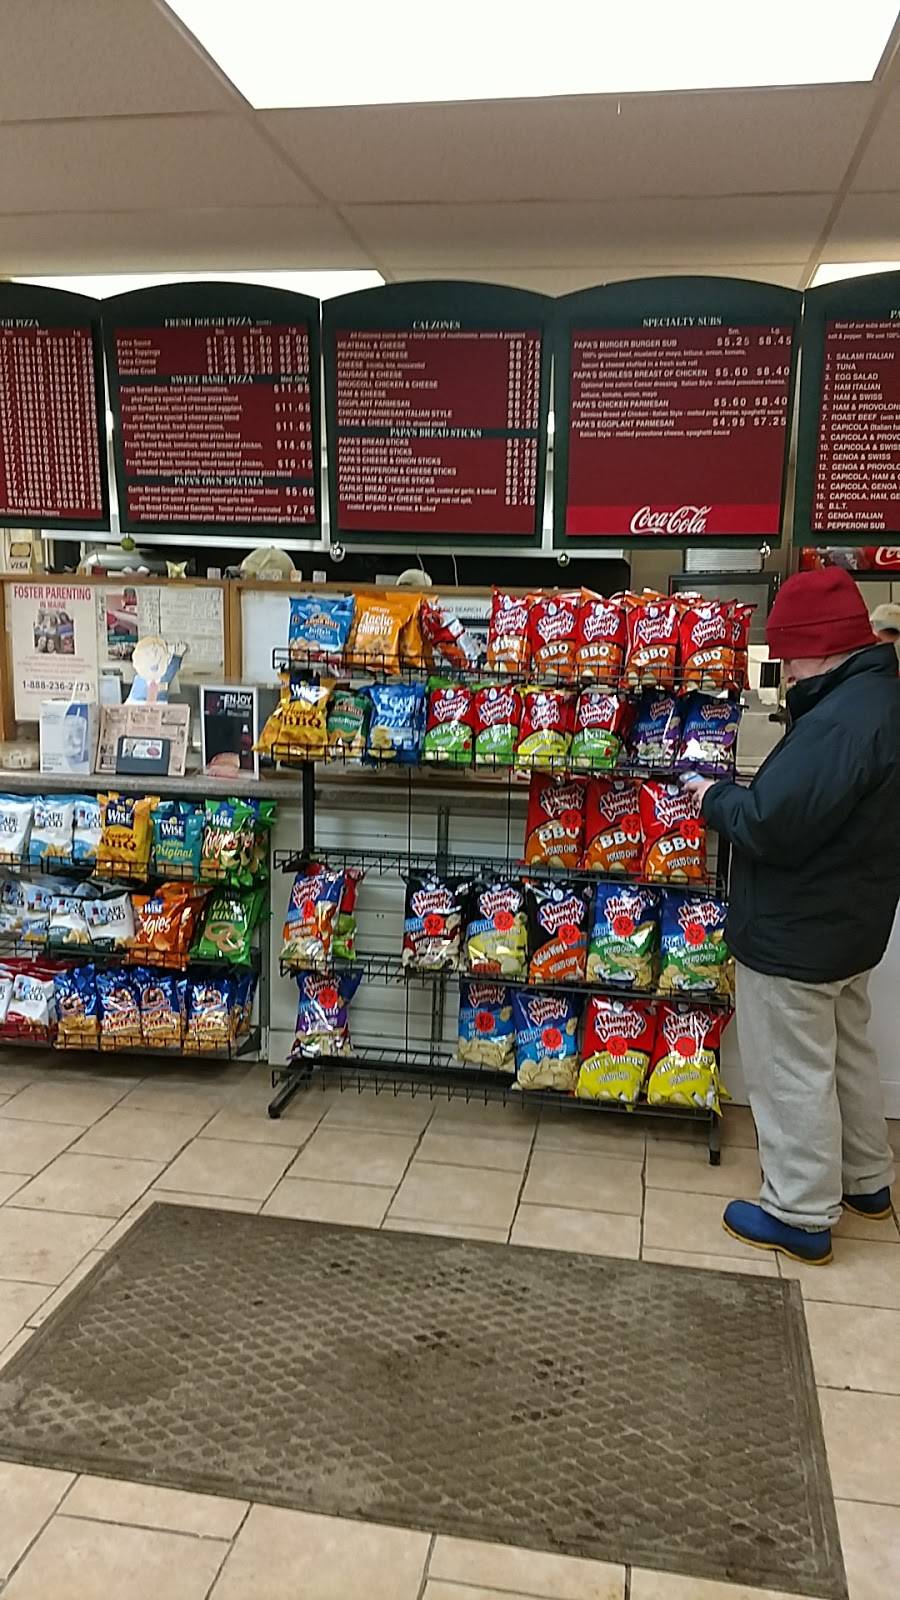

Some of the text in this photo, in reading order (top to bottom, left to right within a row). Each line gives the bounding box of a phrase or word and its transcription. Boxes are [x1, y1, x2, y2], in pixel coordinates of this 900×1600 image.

[16, 318, 40, 328] PIZZA
[227, 316, 252, 327] PIZZA
[412, 319, 461, 330] CALZONES
[642, 316, 722, 327] SPECIALTY SUBS
[574, 340, 598, 349] PAPA'S
[599, 340, 629, 348] BURGER
[630, 340, 661, 348] BURGER
[662, 339, 678, 347] SUB
[675, 369, 708, 377] CHICKEN
[171, 375, 199, 385] SWEET
[228, 375, 253, 384] PIZZA
[572, 401, 596, 409] PAPA'S
[597, 400, 629, 408] CHICKEN
[630, 400, 669, 408] PARMESAN
[831, 413, 856, 421] ROAST
[571, 420, 596, 428] PAPA'S
[597, 420, 635, 428] EGGPLANT
[636, 419, 675, 427] PARMESAN
[451, 428, 482, 438] STICKS
[830, 433, 868, 441] CAPICOLA
[827, 512, 854, 520] GENOA
[14, 586, 92, 600] FOSTER PARENTING
[541, 642, 569, 659] BBQ
[580, 645, 609, 660] BBQ
[640, 647, 669, 661] BBQ
[693, 650, 721, 667] BBQ
[107, 808, 131, 823] WISE
[212, 814, 233, 828] WISE
[161, 823, 185, 836] WISE
[684, 825, 696, 836] $2
[100, 905, 124, 917] CAPE
[144, 903, 163, 914] WISE
[213, 900, 248, 912] ONN
[541, 896, 583, 917] Humpty
[106, 913, 126, 921] COD
[541, 911, 584, 934] Dumpty
[429, 919, 440, 929] $2
[598, 1011, 643, 1028] Humpty
[597, 1024, 643, 1043] Dumpty
